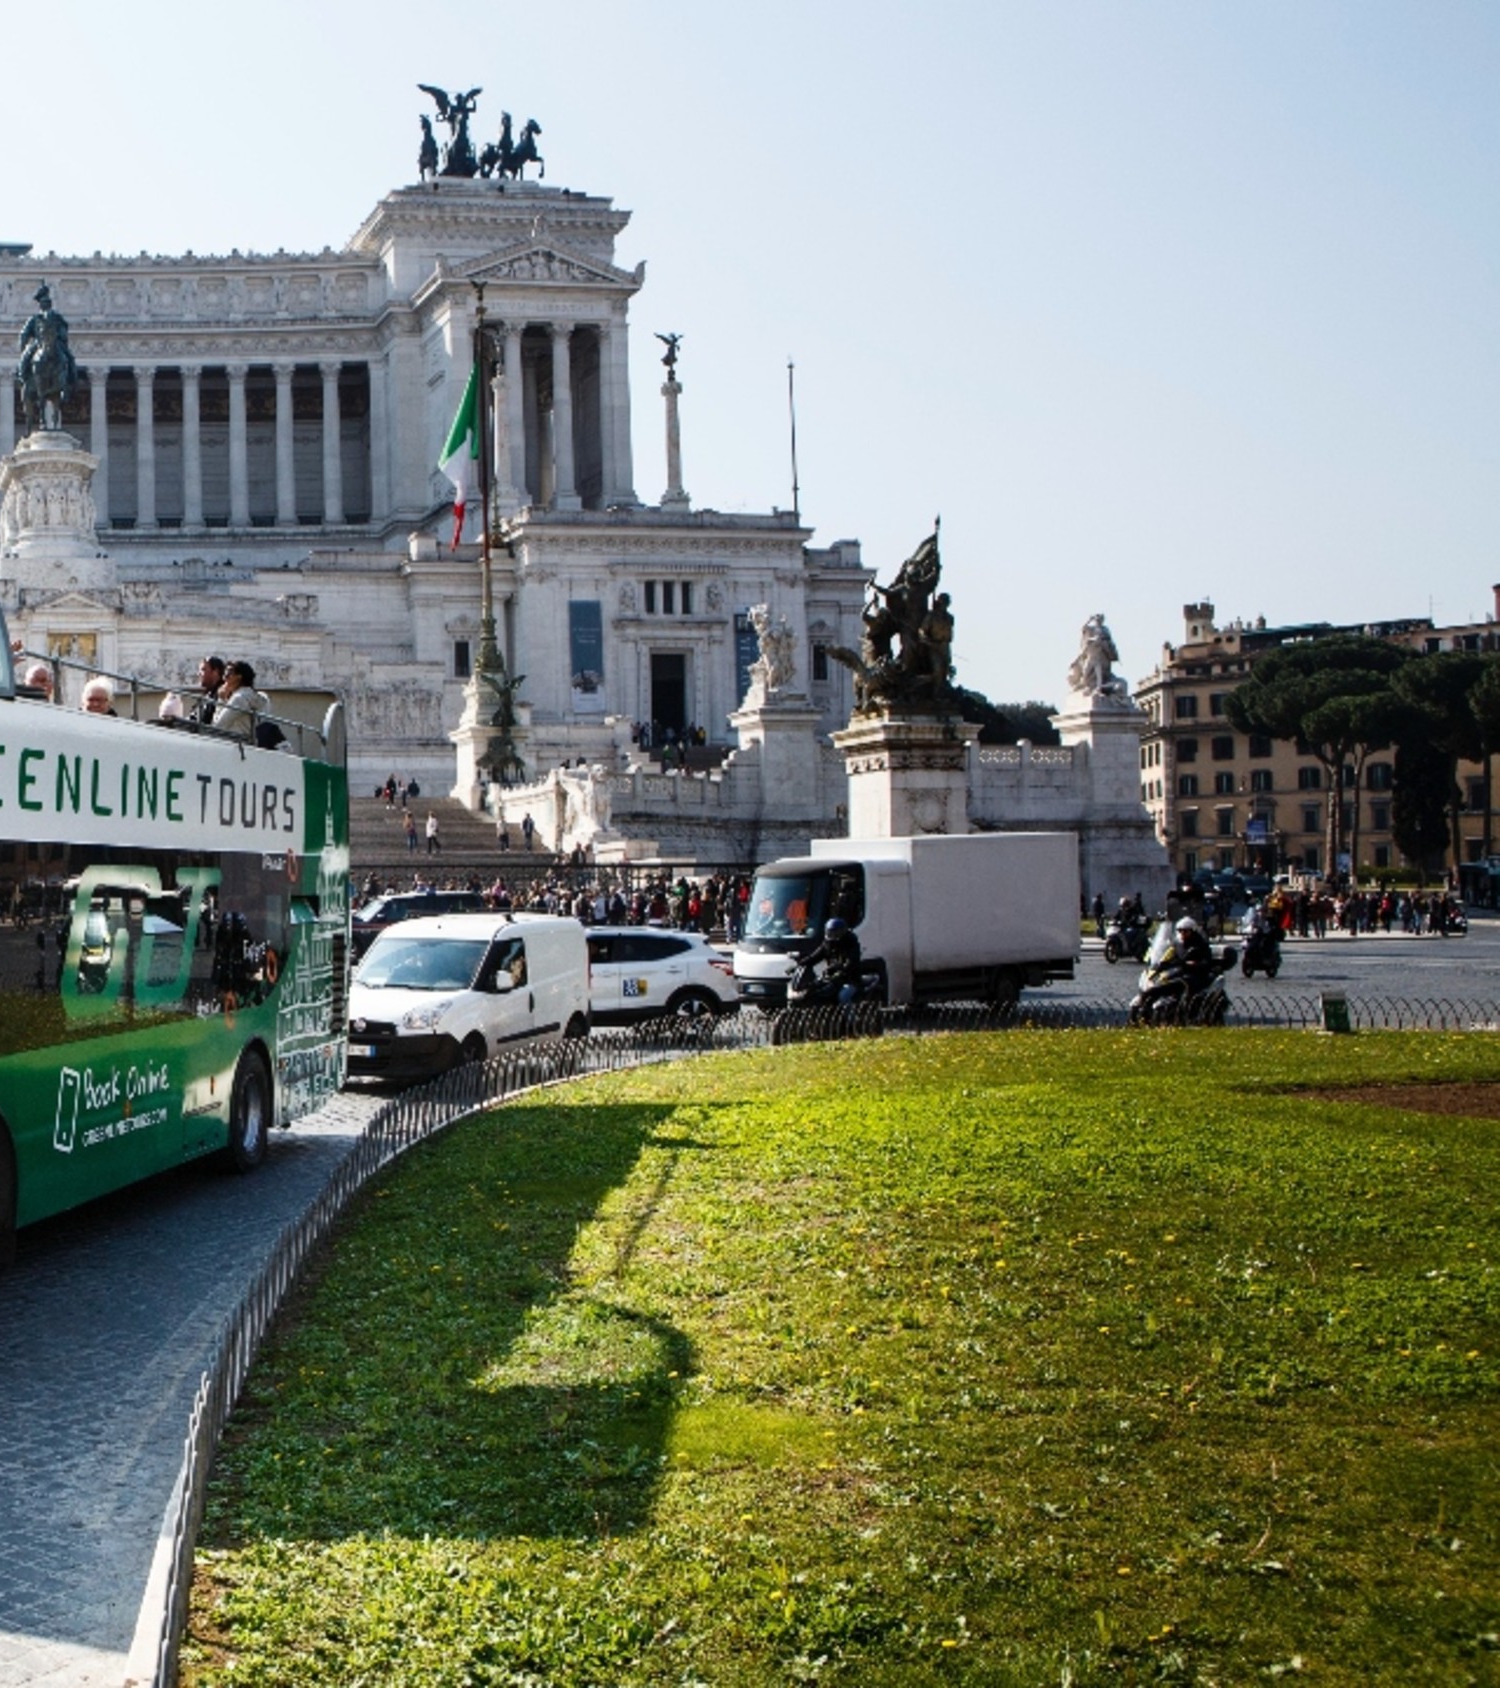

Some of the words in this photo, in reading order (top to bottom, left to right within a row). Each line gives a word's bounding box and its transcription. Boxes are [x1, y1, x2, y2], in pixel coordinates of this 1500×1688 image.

[196, 773, 295, 832] TOURS
[84, 1066, 121, 1110] Book
[126, 1058, 170, 1100] Online
